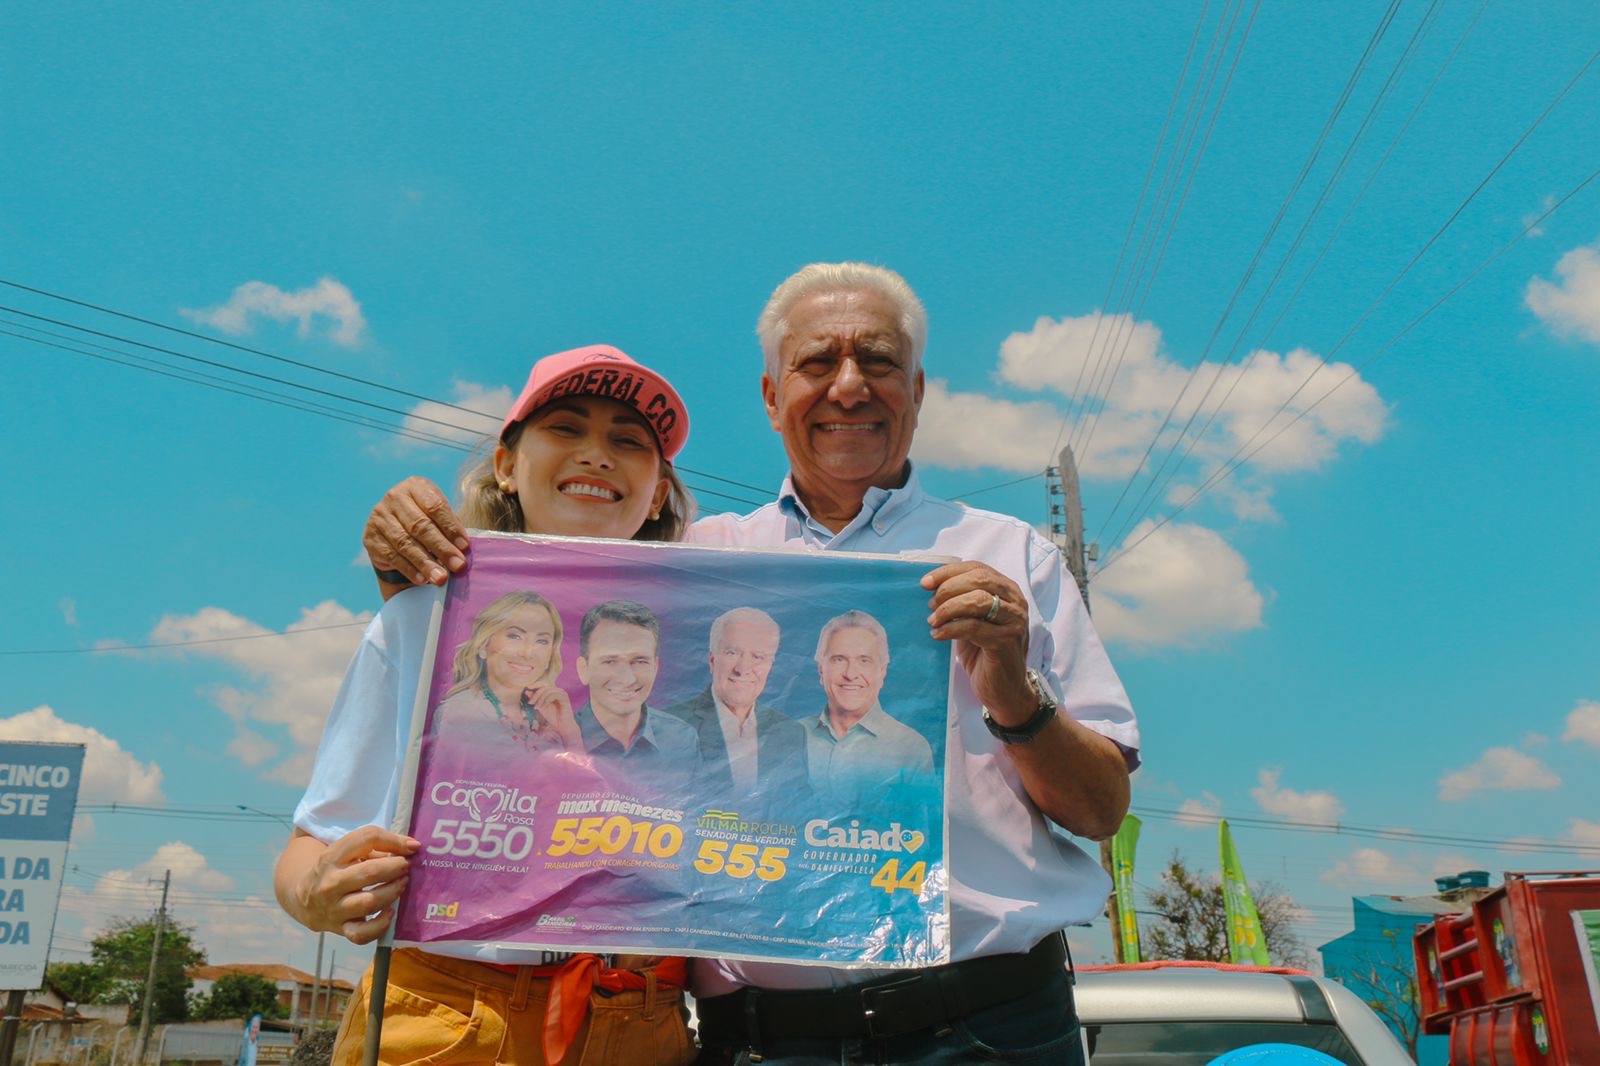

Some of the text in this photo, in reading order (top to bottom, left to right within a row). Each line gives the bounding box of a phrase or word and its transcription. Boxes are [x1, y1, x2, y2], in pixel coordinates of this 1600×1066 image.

[536, 369, 677, 443] EDERAL CO.
[0, 763, 70, 788] CINCO
[0, 792, 50, 816] STE
[431, 781, 538, 822] Camila
[561, 791, 640, 803] DEPUTADO ESTADUAL
[503, 813, 535, 826] Rosa
[557, 799, 684, 823] max menezes
[545, 815, 685, 859] 55010
[695, 828, 798, 847] SENADOR DE VERDADE
[696, 816, 798, 836] VILMAR ROCHA
[426, 819, 534, 861] 5550
[12, 856, 50, 881] DA
[429, 860, 454, 868] NOSSA
[455, 862, 471, 870] VOZ
[506, 865, 530, 873] CALA!
[543, 859, 592, 870] TRABALHANDO
[592, 859, 608, 869] COM
[608, 859, 641, 869] CORAGEM
[642, 861, 658, 869] POR
[693, 839, 790, 882] 555
[803, 849, 878, 864] GOVERNADOR
[810, 863, 843, 873] DANIEL
[843, 865, 875, 876] VILELA
[870, 857, 927, 896] 44
[425, 901, 460, 920] psd
